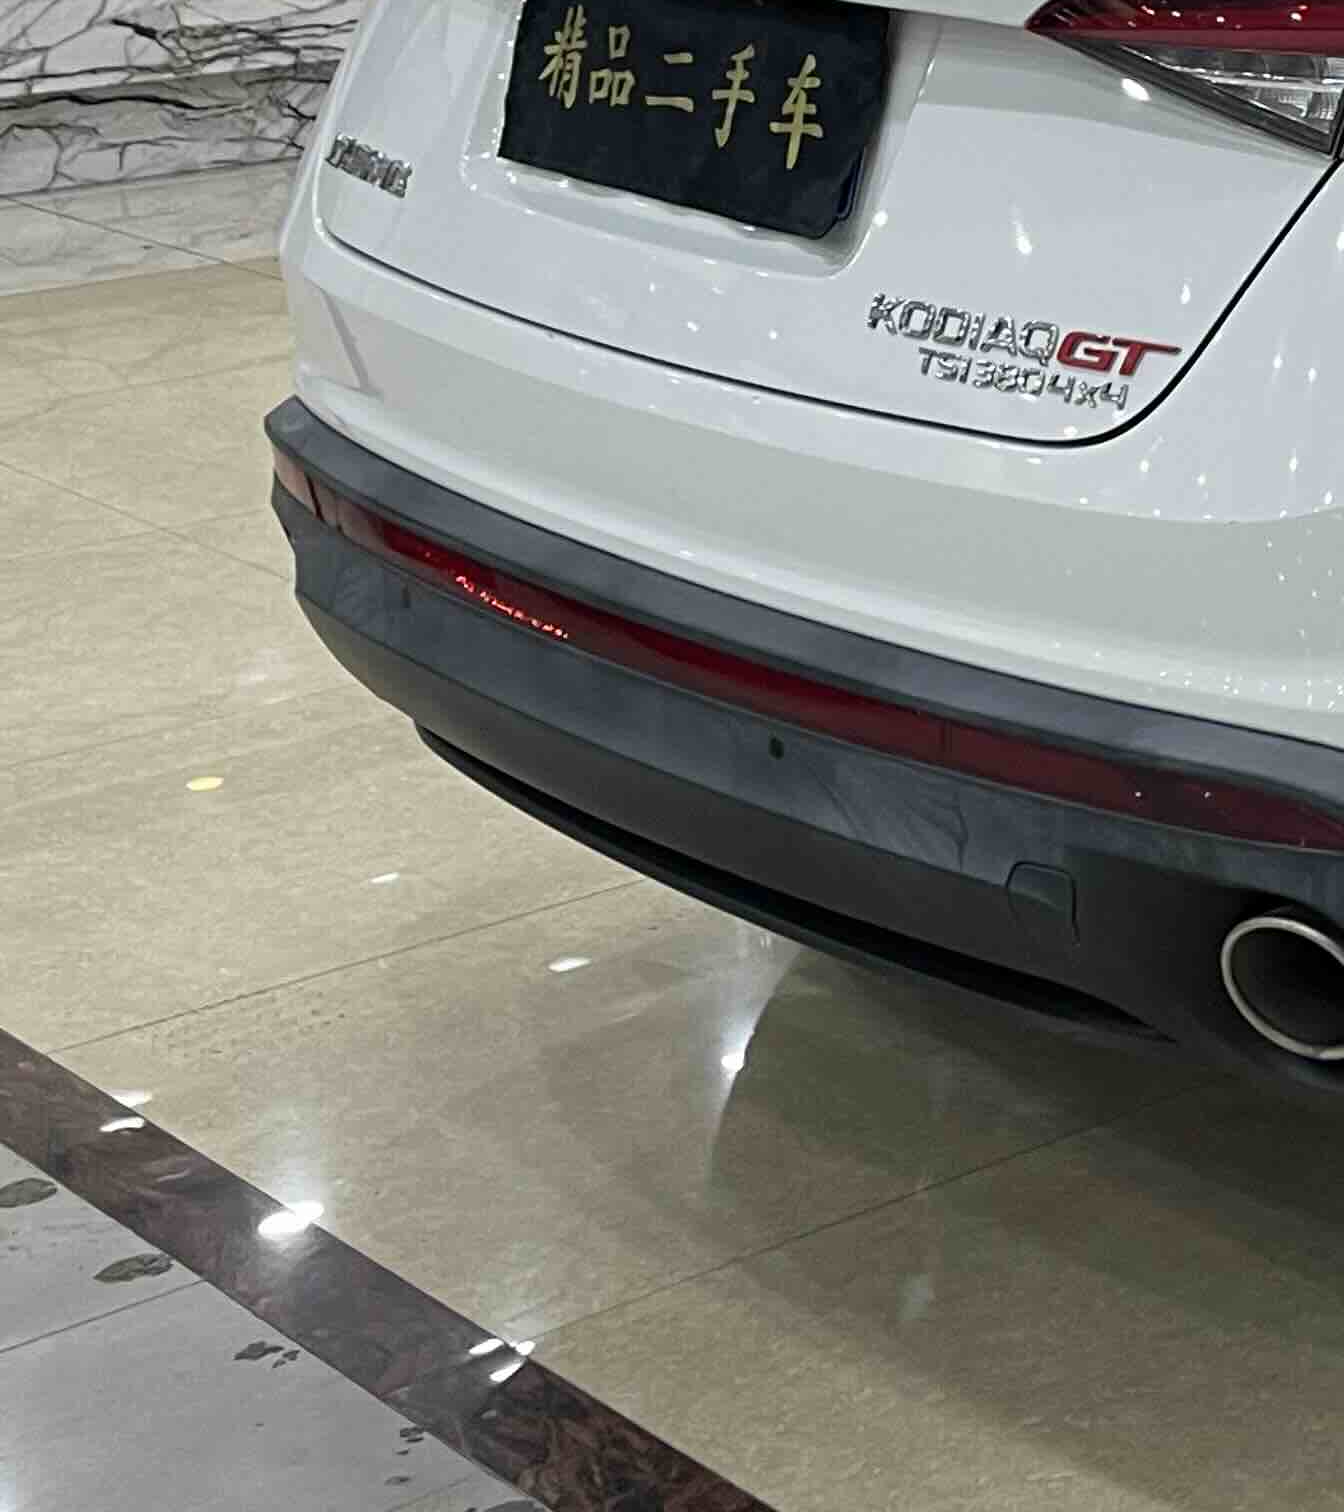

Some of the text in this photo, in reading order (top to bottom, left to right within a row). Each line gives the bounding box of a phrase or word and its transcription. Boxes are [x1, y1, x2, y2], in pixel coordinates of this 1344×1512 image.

[537, 3, 826, 171] 精品二手车
